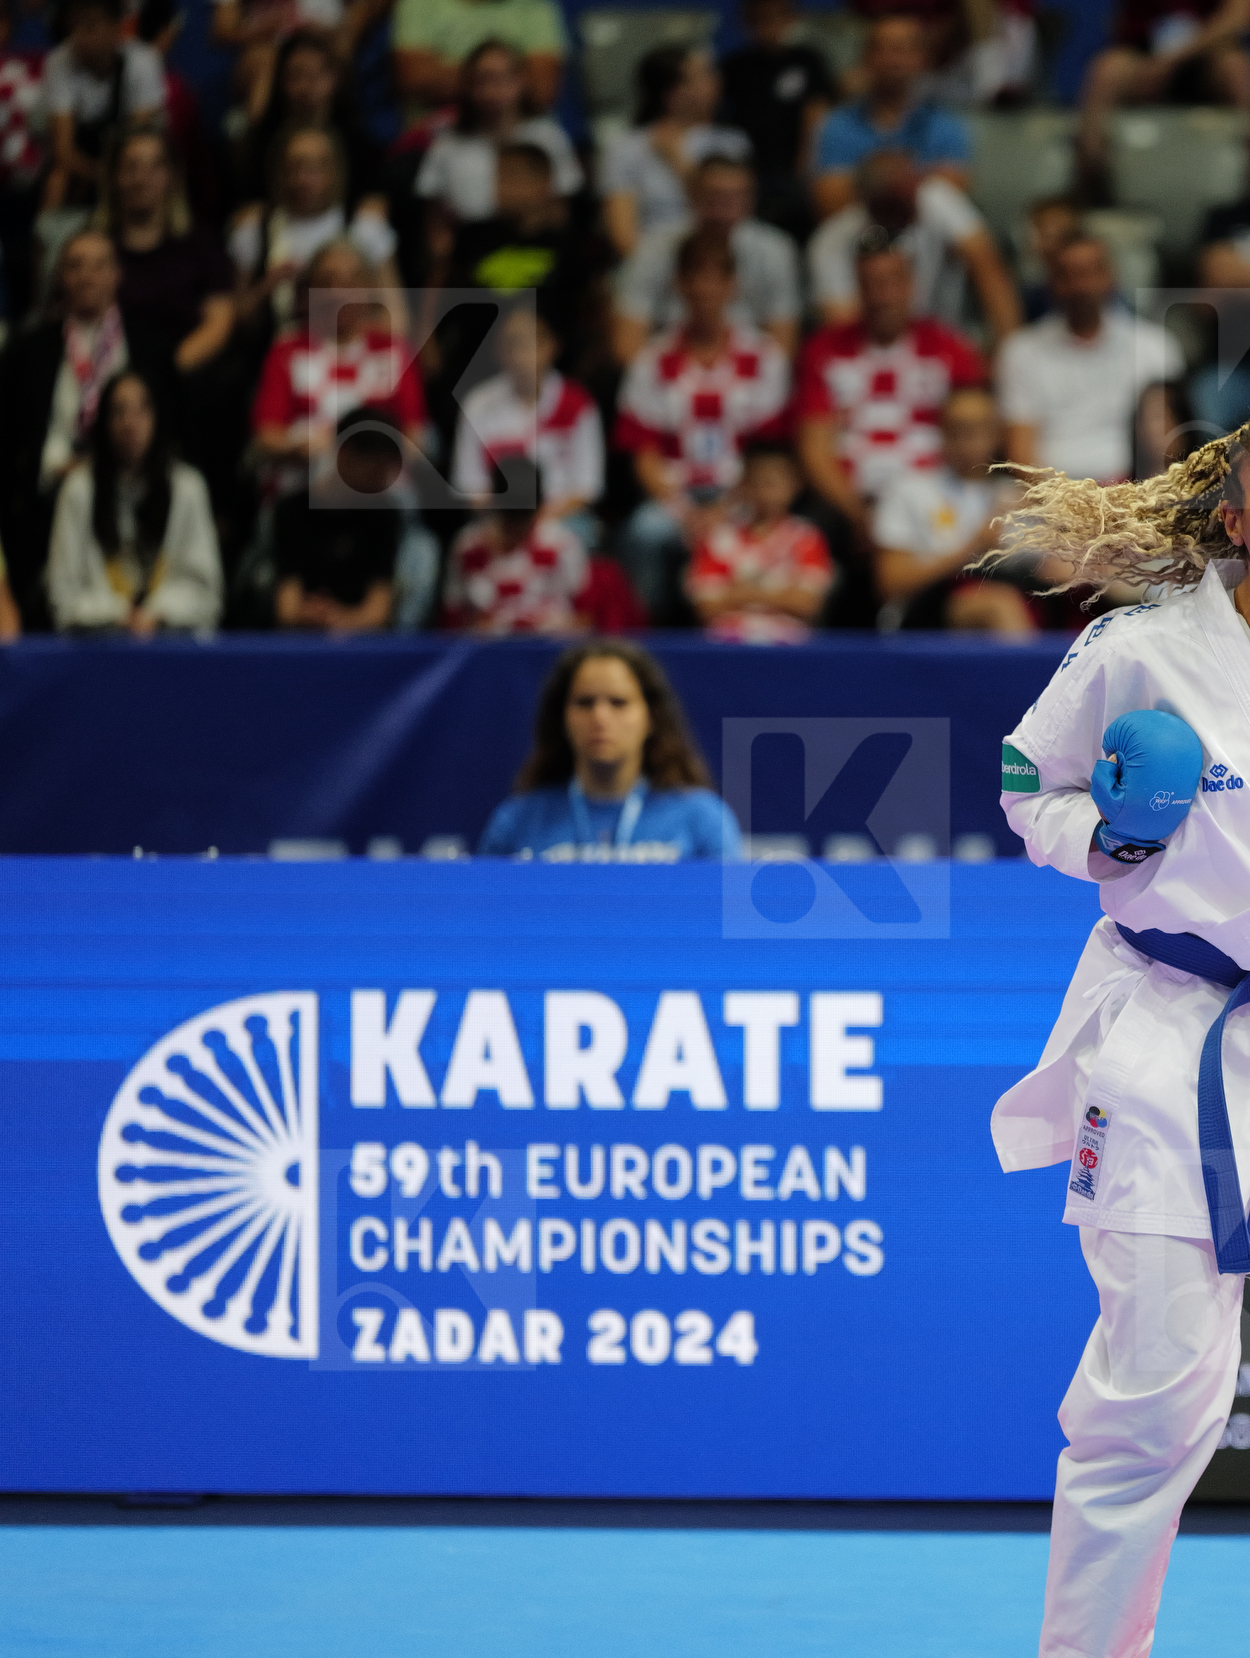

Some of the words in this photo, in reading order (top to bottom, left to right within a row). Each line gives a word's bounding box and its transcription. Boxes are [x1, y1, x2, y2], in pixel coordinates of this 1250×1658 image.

[1001, 762, 1037, 777] berdrola
[350, 989, 884, 1111] KARATE
[349, 1140, 503, 1199] 59th
[526, 1143, 868, 1201] EUROPEAN
[349, 1217, 885, 1276] CHAMPIONSHIPS
[350, 1307, 564, 1364] ZADAR
[587, 1309, 759, 1365] 2024
